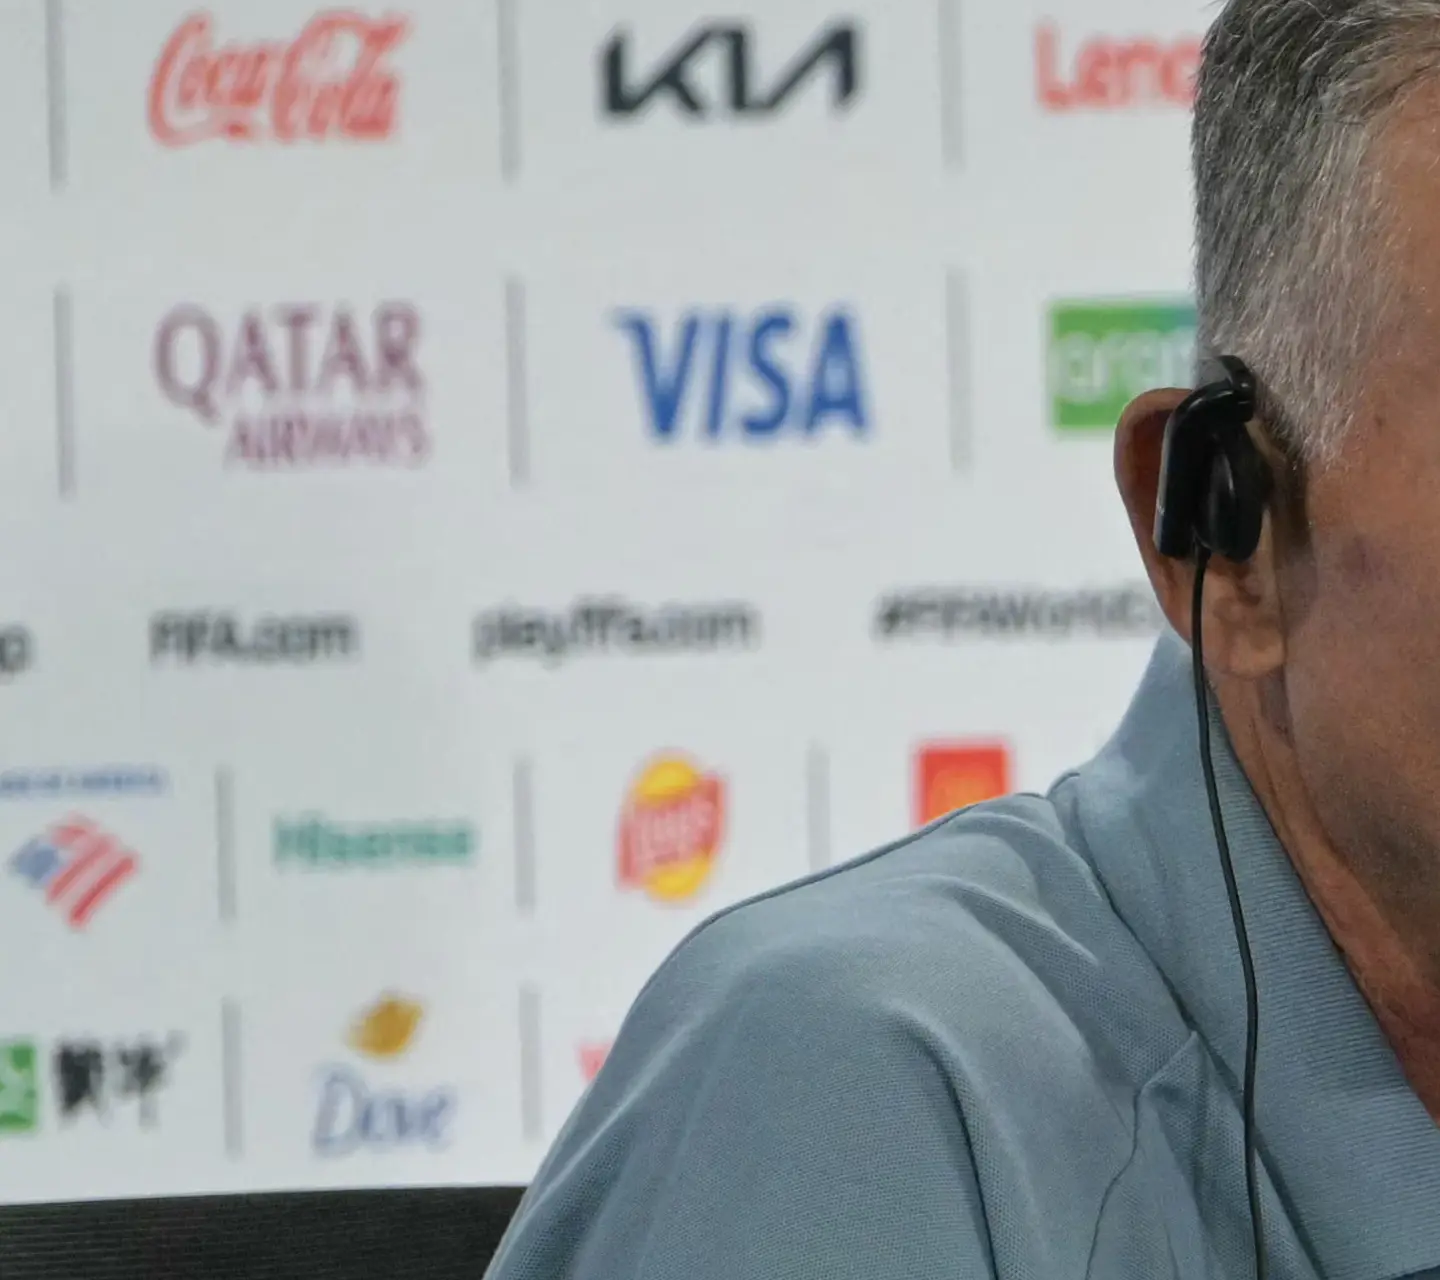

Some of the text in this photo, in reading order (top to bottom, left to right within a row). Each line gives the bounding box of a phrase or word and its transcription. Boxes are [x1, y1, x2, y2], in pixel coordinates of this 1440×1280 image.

[147, 11, 407, 146] Coca-Cola
[600, 23, 860, 119] KIA
[1036, 26, 1198, 110] Leno
[154, 304, 422, 422] QATAR
[620, 308, 868, 442] VISA
[228, 411, 425, 468] AIRWAYS
